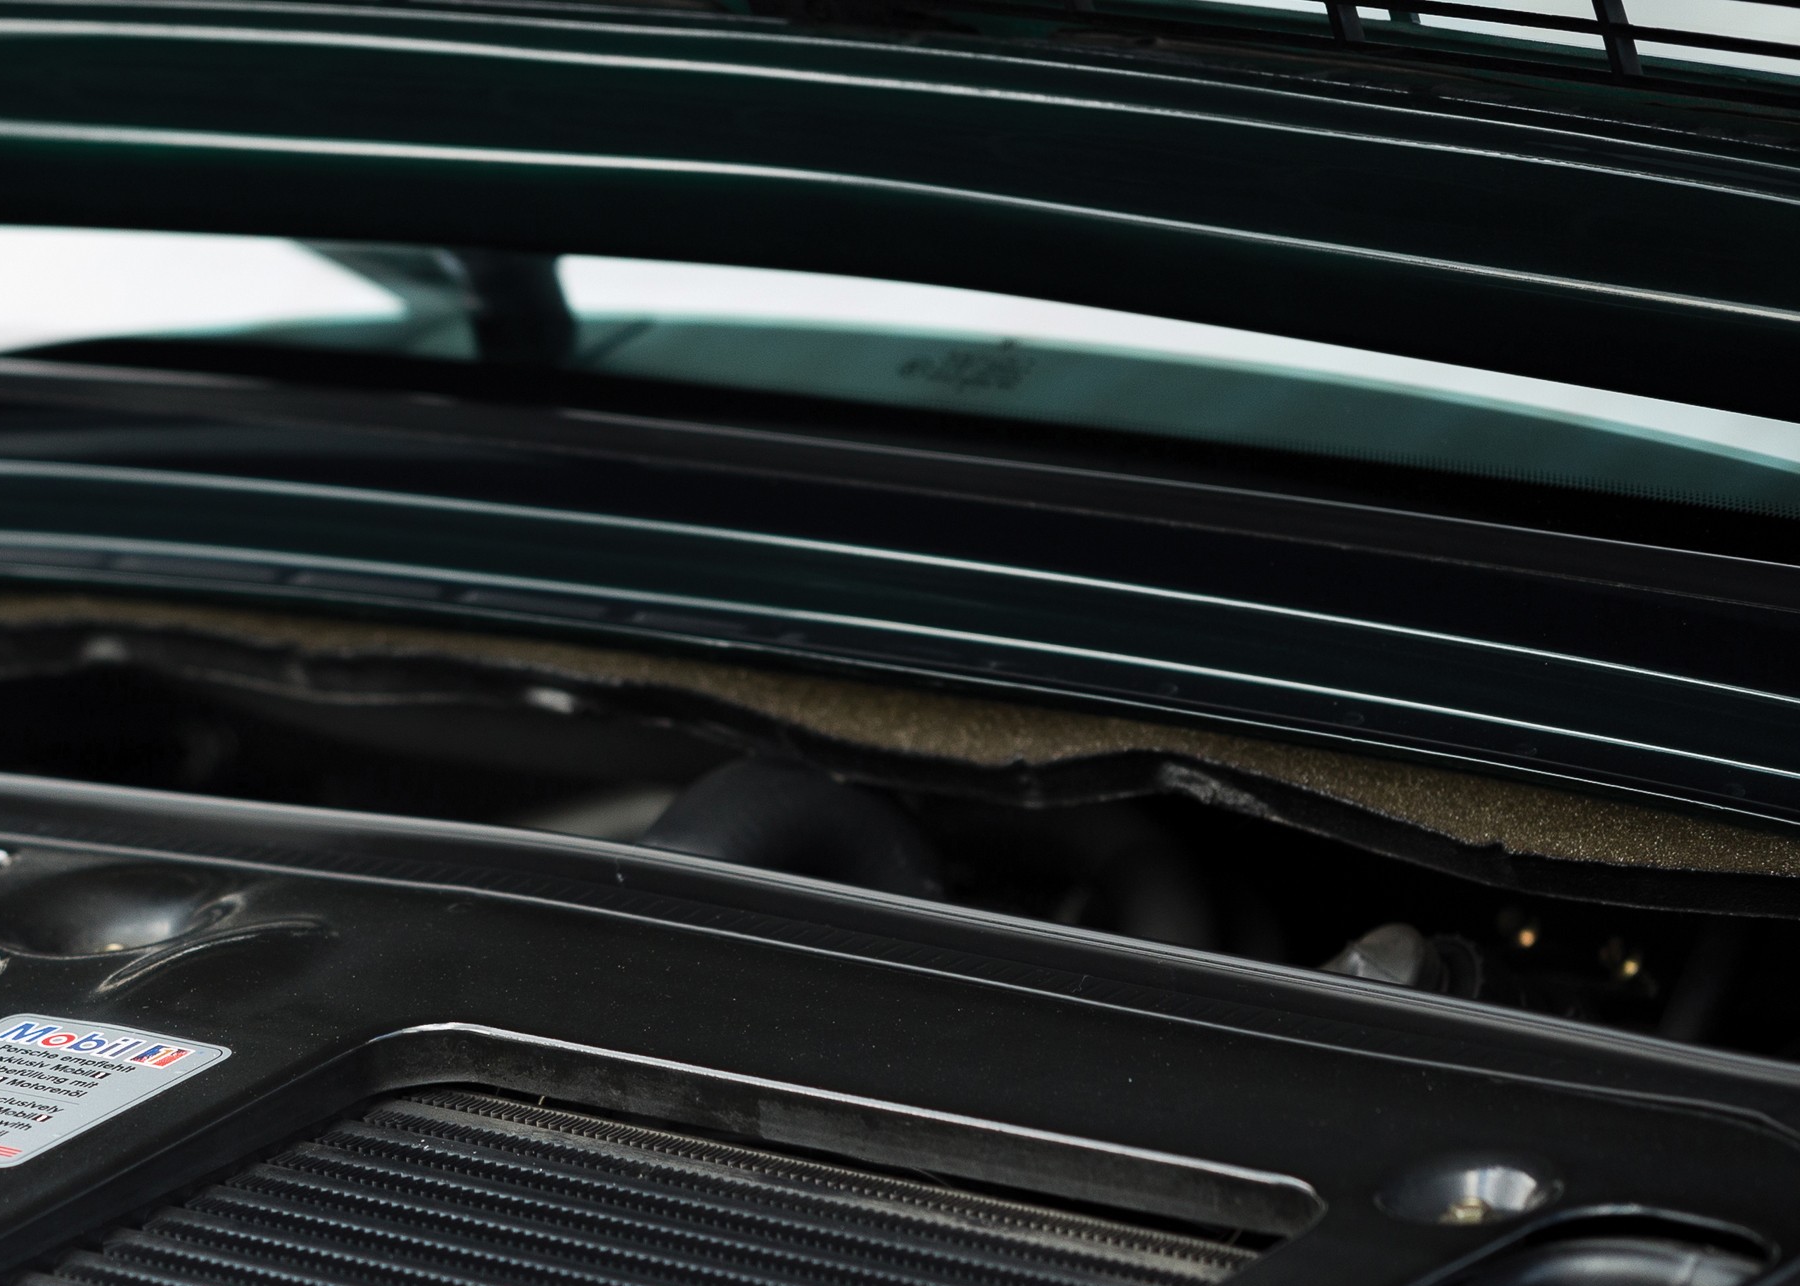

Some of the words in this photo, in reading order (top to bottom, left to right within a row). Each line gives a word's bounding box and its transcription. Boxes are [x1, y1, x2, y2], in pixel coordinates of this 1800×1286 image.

[59, 1055, 136, 1073] empfiehlt
[5, 1078, 88, 1098] Motorenöl
[68, 1079, 99, 1089] mit
